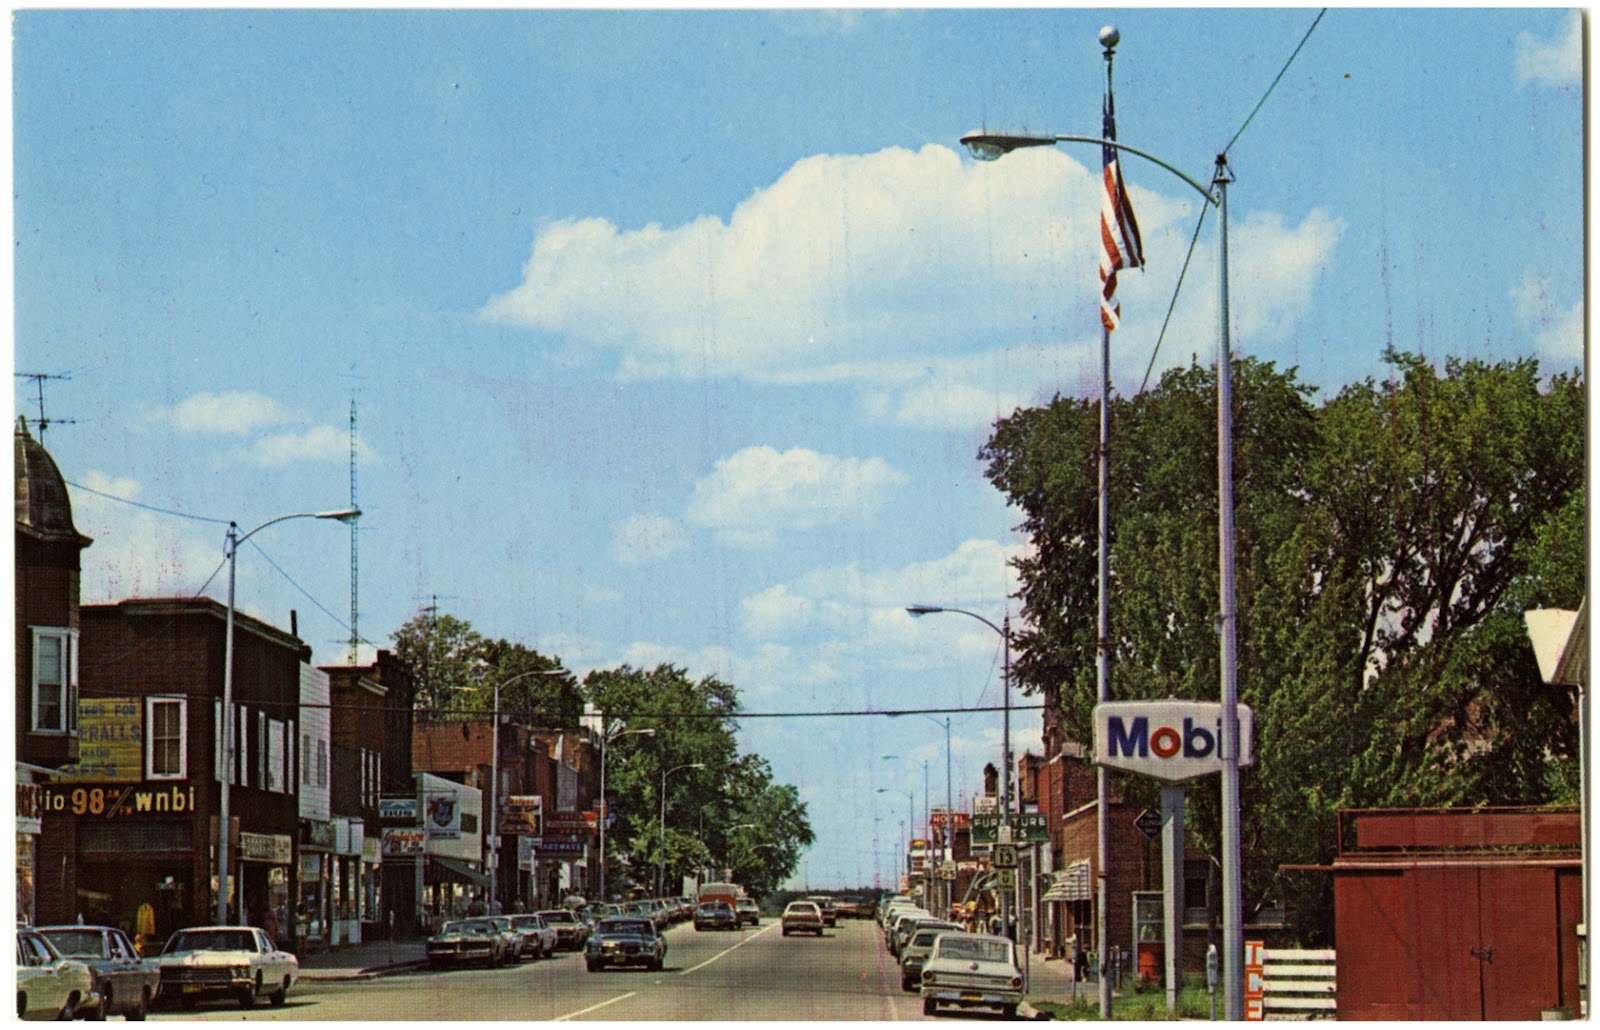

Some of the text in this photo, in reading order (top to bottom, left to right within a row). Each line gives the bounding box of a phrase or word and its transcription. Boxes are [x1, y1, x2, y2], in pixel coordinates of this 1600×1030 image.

[114, 705, 136, 715] FOR
[1108, 716, 1240, 758] Mobi
[71, 788, 105, 815] 98
[135, 786, 195, 812] wnbi
[974, 818, 1046, 827] FURTURE
[988, 830, 1027, 839] GTS
[999, 852, 1013, 863] 13
